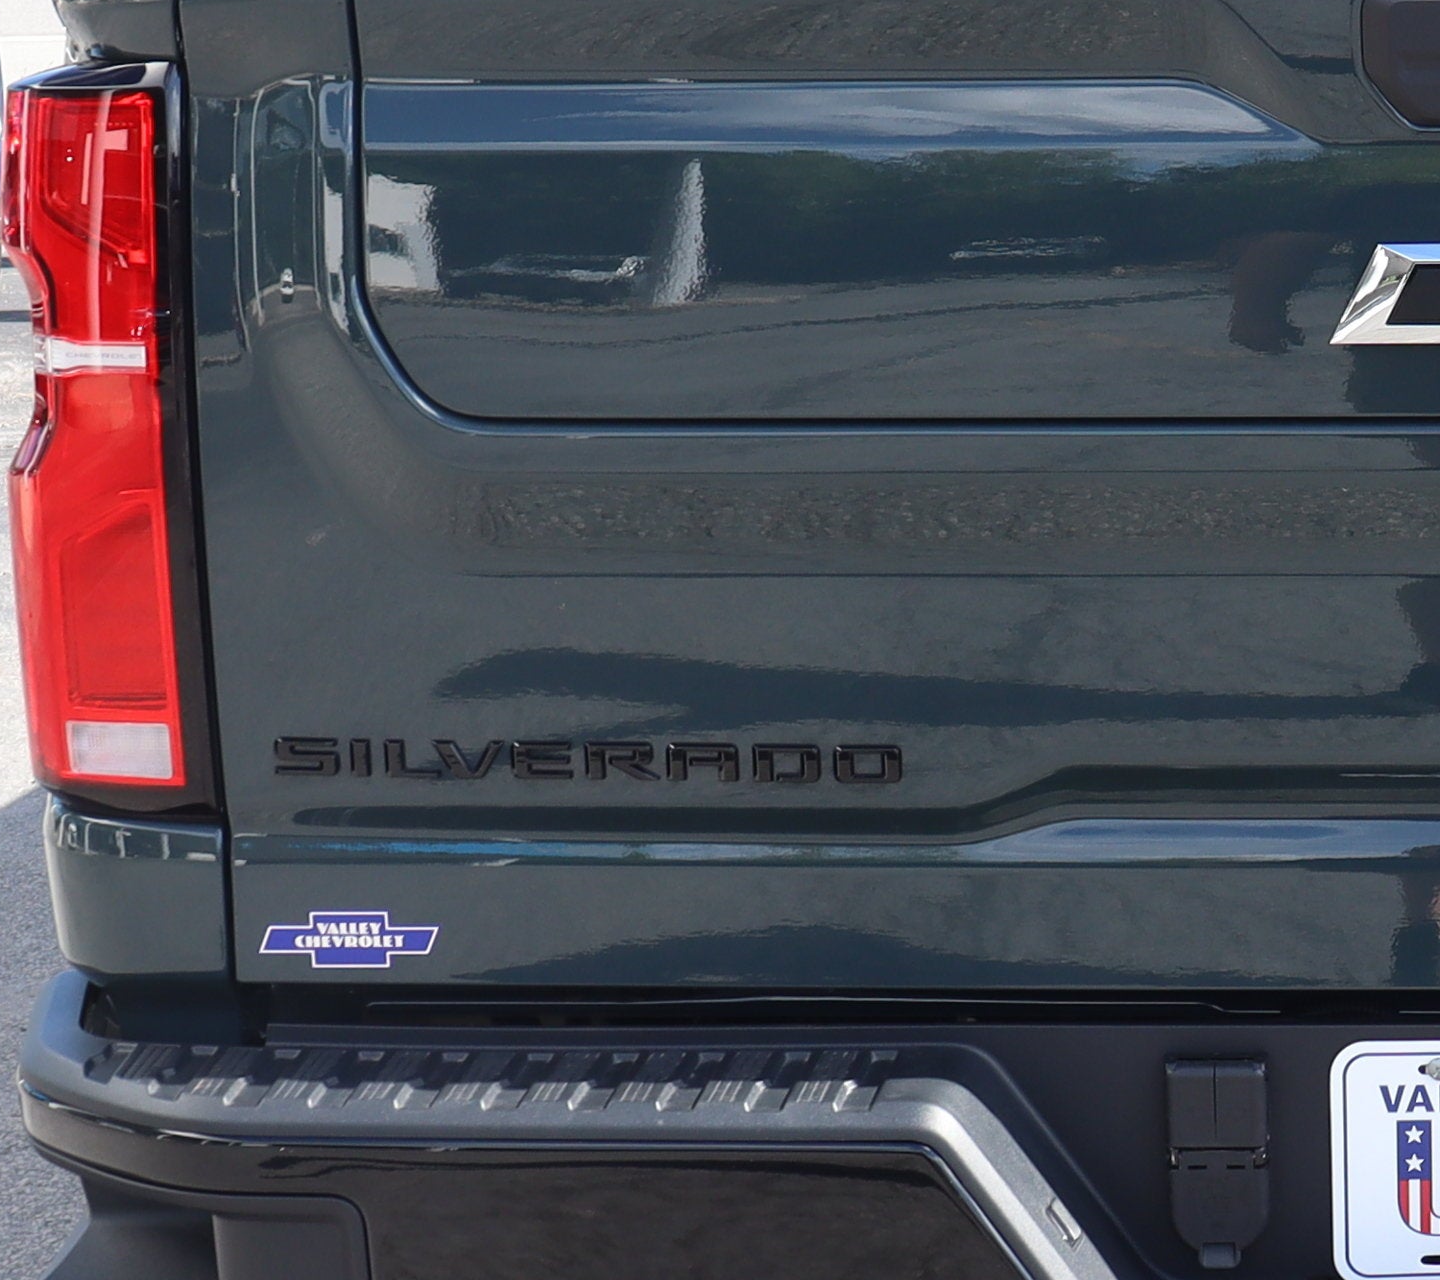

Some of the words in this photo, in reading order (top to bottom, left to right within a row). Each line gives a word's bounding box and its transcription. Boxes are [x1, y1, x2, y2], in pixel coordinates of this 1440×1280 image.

[274, 736, 903, 784] SILVERADO
[316, 922, 382, 935] VALLEY
[294, 935, 405, 948] CHEVROLET
